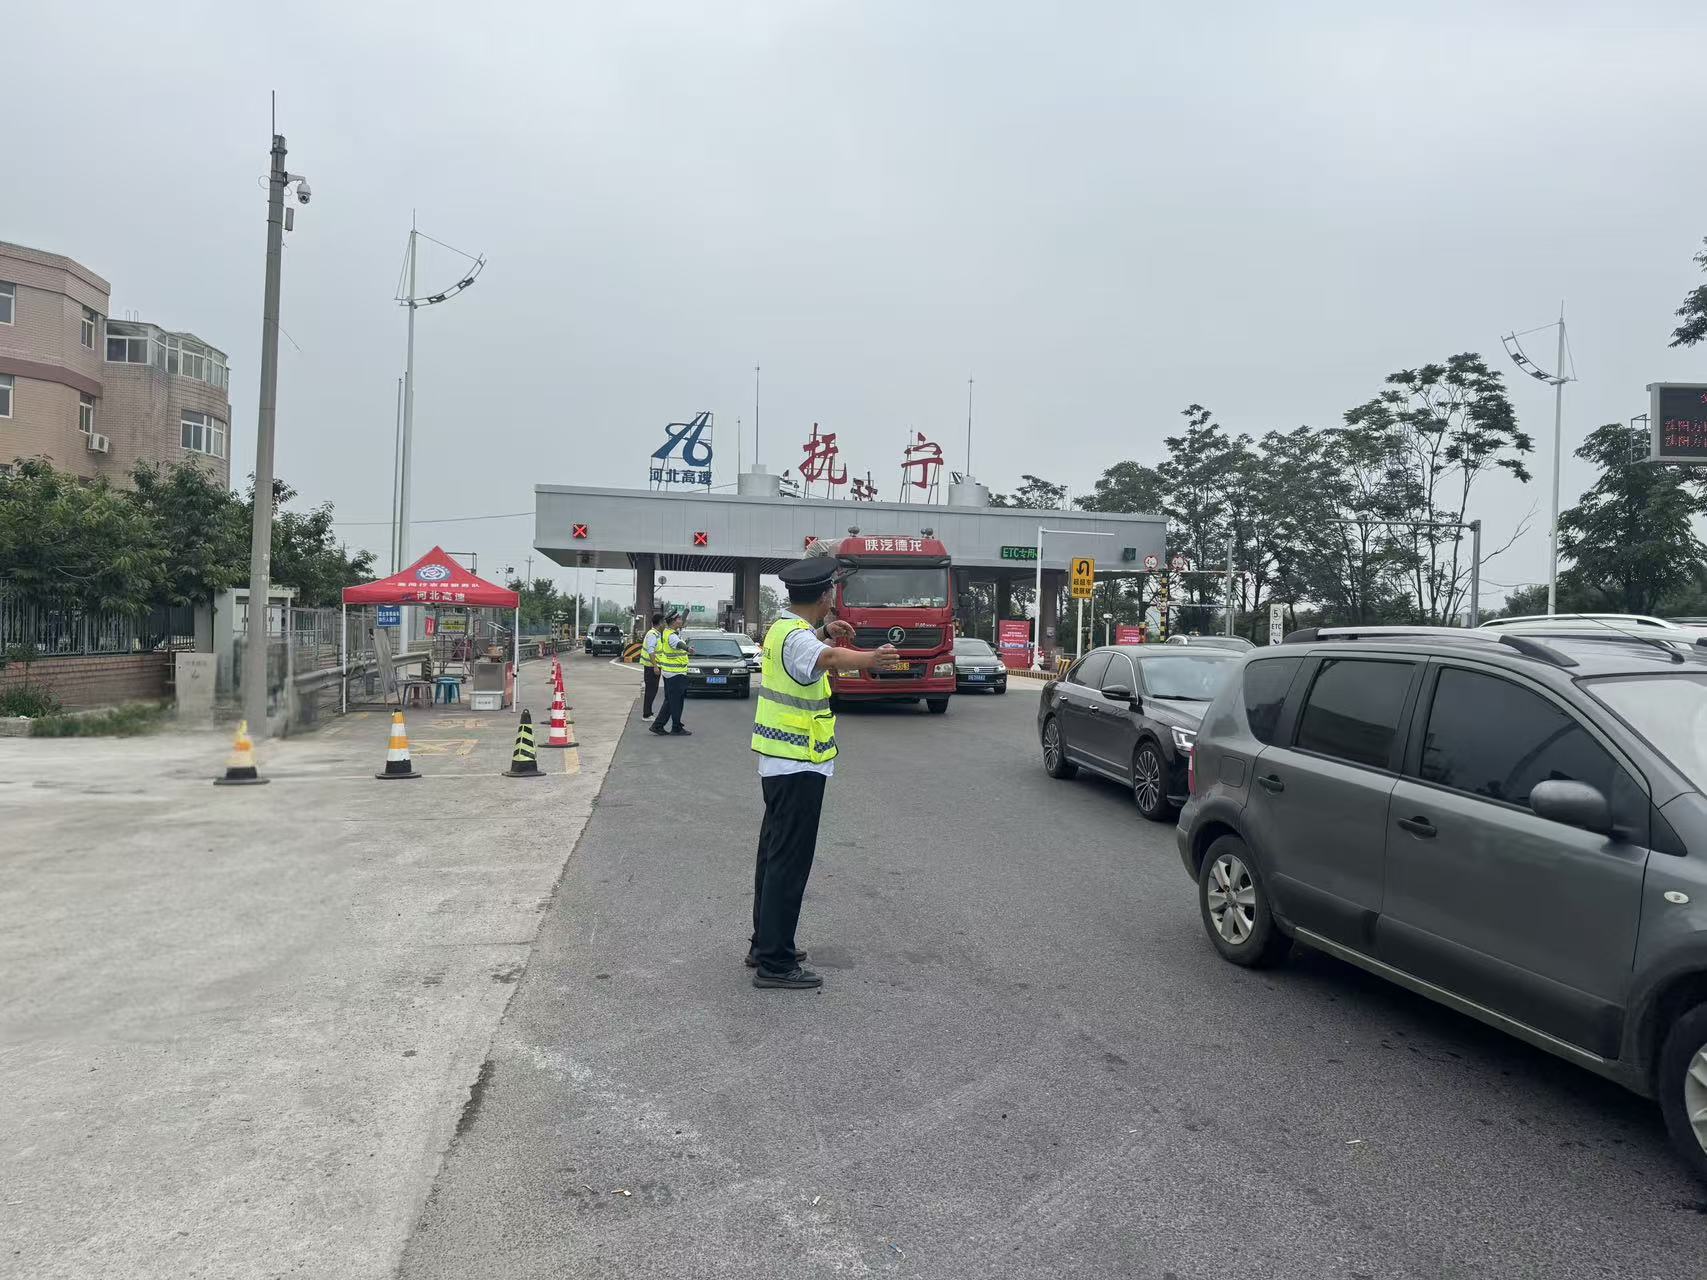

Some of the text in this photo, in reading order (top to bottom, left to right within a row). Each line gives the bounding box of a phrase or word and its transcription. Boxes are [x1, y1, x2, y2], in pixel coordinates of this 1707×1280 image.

[799, 422, 944, 489] 抚宁
[649, 467, 712, 485] 河北高速
[865, 539, 922, 552] 陕汽德龙
[417, 591, 465, 601] 河北高速
